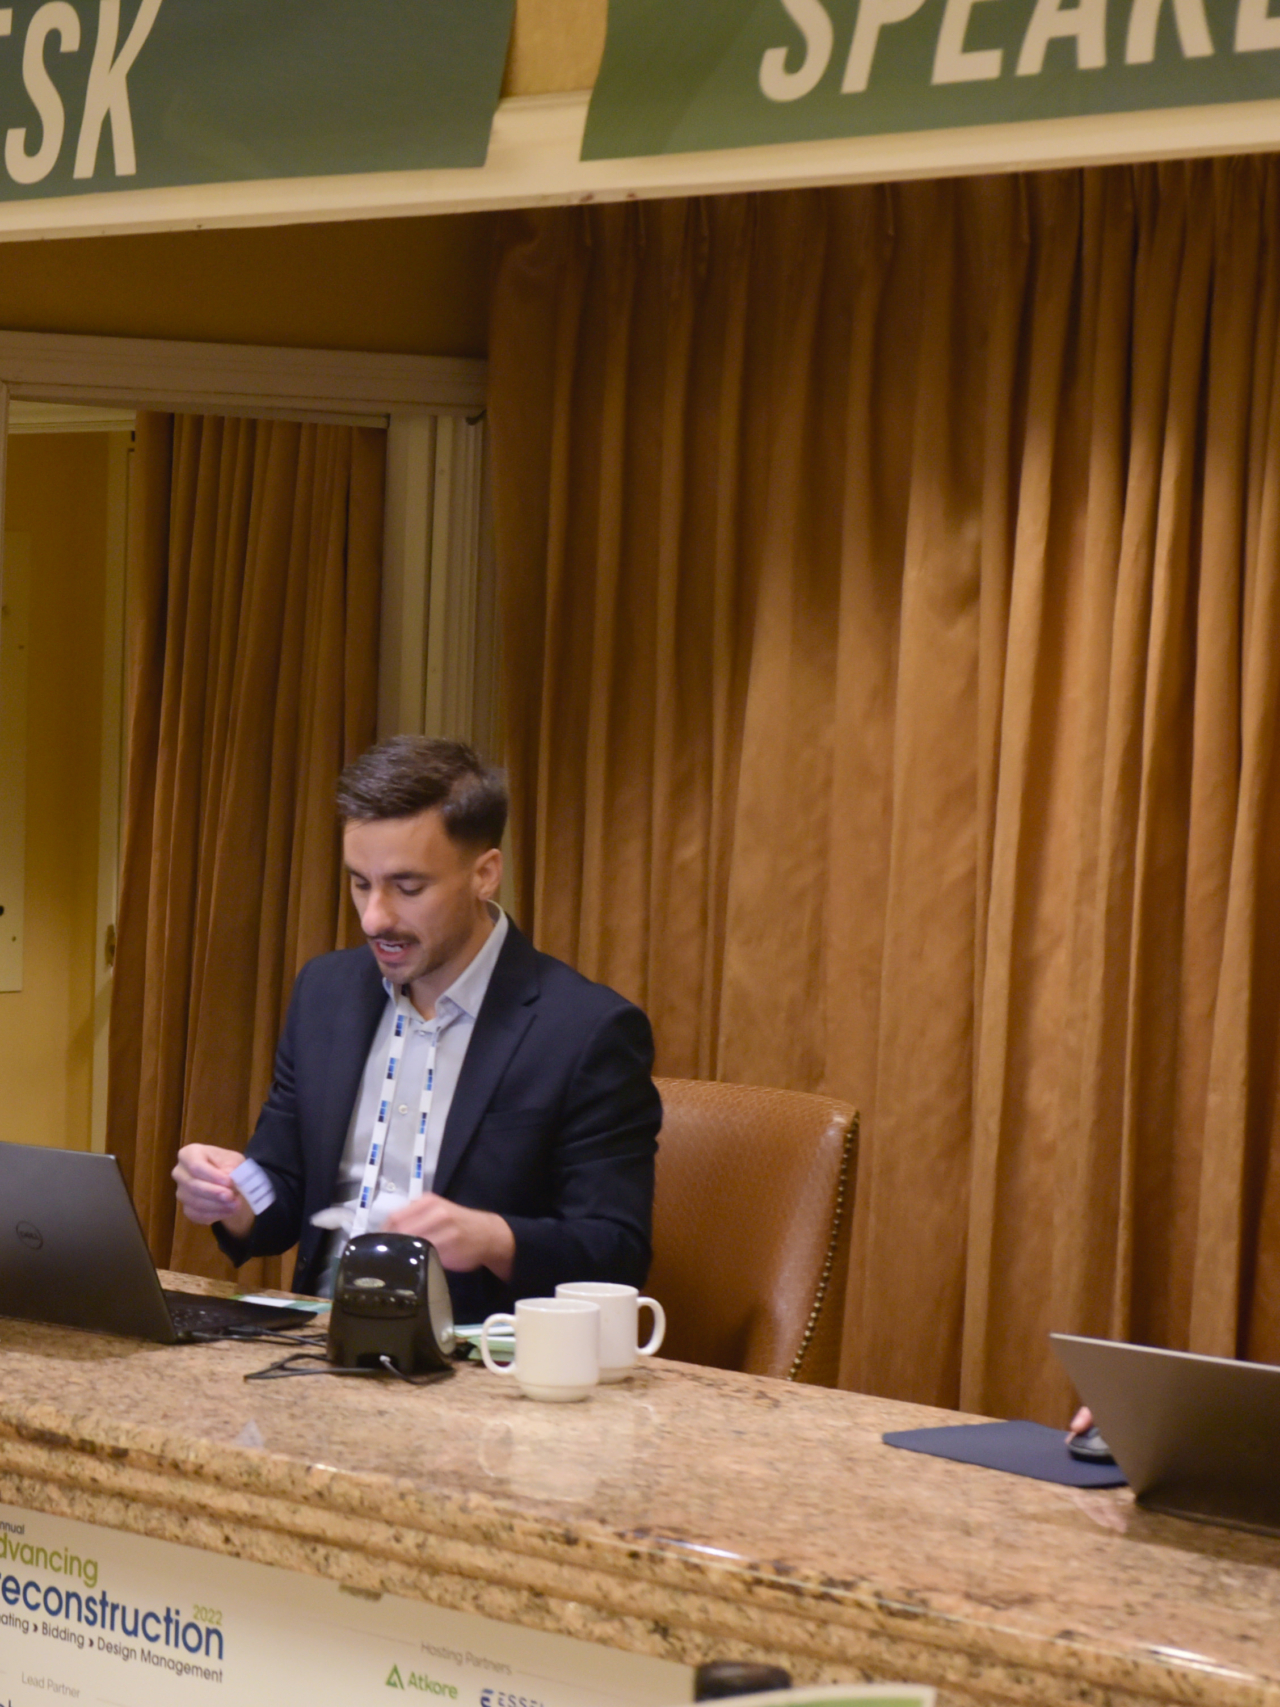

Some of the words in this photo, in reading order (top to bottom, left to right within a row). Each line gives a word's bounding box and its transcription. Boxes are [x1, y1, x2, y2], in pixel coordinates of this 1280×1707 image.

[192, 1604, 223, 1626] 2022
[41, 1621, 85, 1649] Bidding
[97, 1636, 137, 1663] Design
[140, 1647, 223, 1684] Management
[421, 1642, 464, 1667] Hosting
[465, 1650, 513, 1676] Partners
[21, 1671, 45, 1690] Lead
[46, 1678, 81, 1699] Partner
[407, 1671, 459, 1700] Atkore
